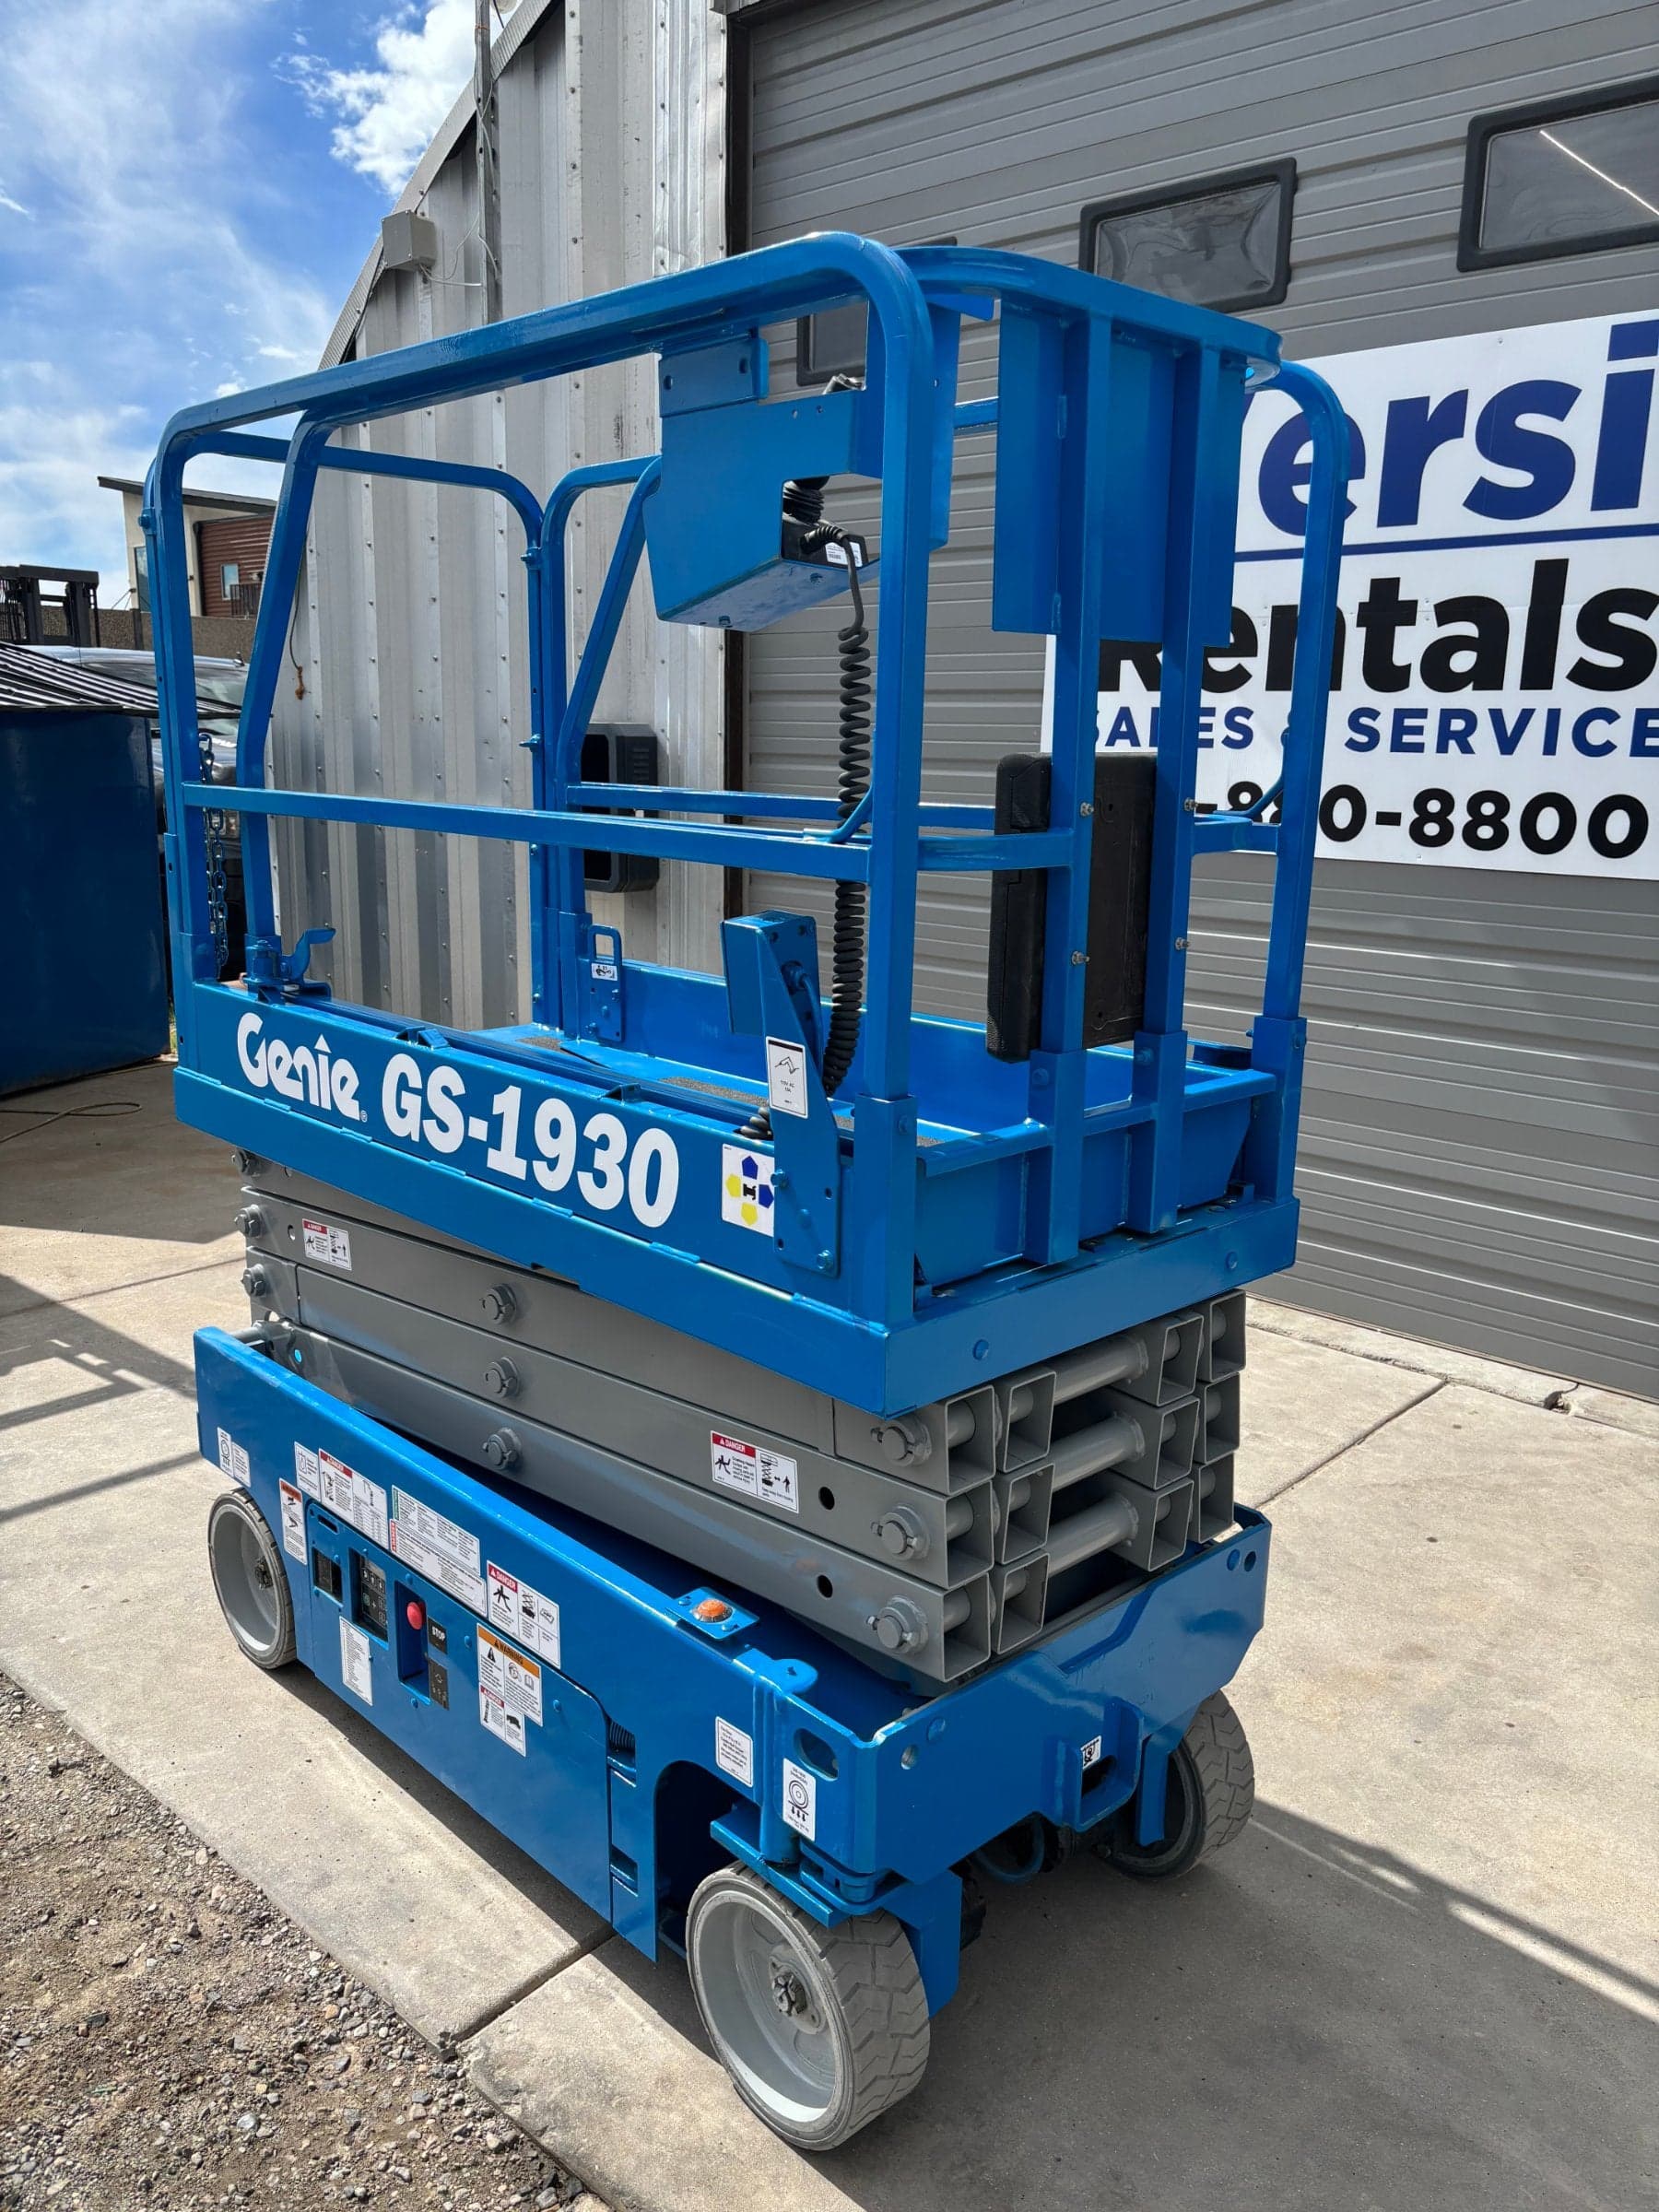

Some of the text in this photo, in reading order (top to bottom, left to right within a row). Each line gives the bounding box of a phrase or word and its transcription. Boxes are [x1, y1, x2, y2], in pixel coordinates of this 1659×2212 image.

[1243, 320, 1659, 535] ersi
[1096, 706, 1254, 749] AES
[1345, 707, 1659, 758] SERVICE
[237, 1013, 360, 1121] Genie
[382, 1053, 679, 1228] GS-1930
[724, 1439, 746, 1453] DANGER
[496, 1571, 517, 1592] DANGER
[431, 1626, 446, 1641] STOP
